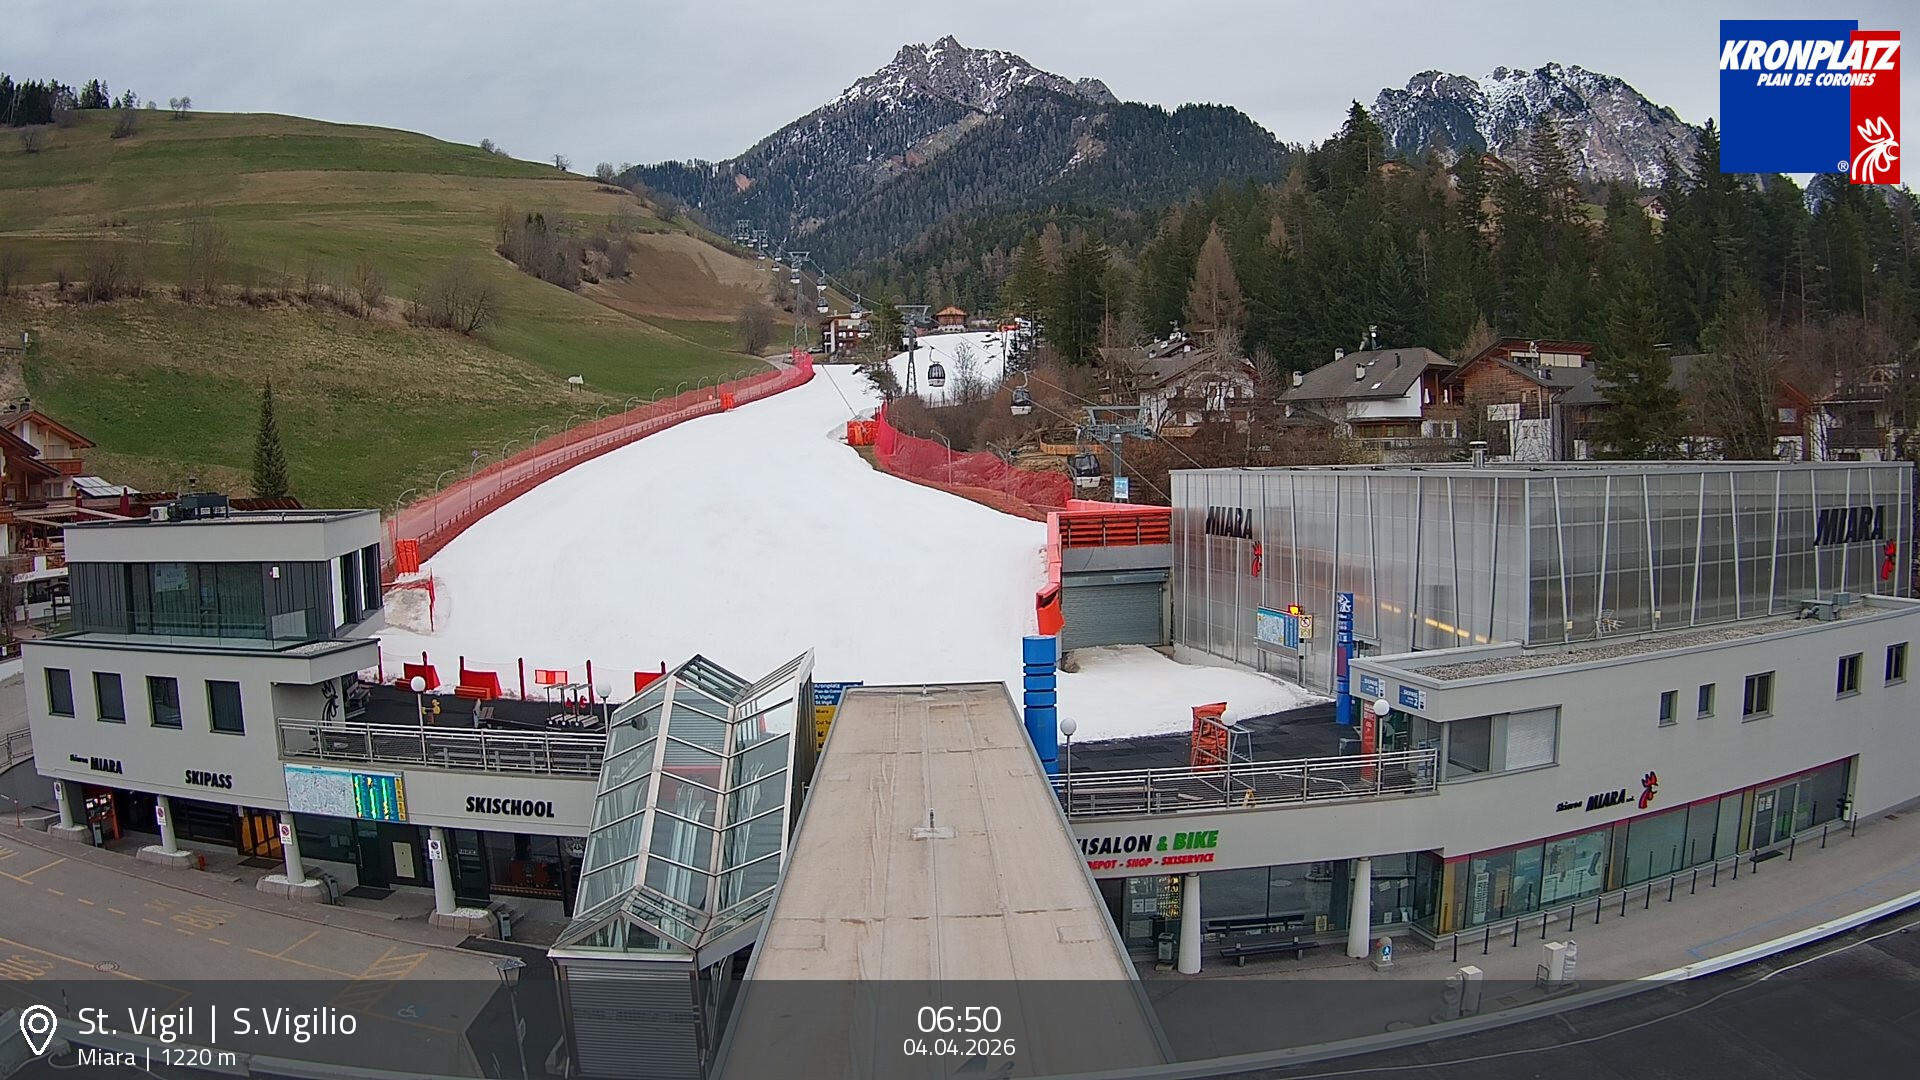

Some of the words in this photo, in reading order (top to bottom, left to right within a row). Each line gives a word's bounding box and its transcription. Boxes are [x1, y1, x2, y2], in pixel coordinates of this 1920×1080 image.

[1206, 506, 1252, 539] MIARA
[1813, 505, 1884, 547] MIARA
[90, 757, 123, 774] MIARA
[185, 769, 233, 789] SKIPASS
[466, 796, 554, 818] SKISCHOOL
[1586, 788, 1626, 812] MIARA
[1156, 835, 1168, 852] &
[1173, 830, 1219, 851] BIKE
[1126, 857, 1153, 868] SHOP
[1161, 853, 1214, 865] SKISERVICE
